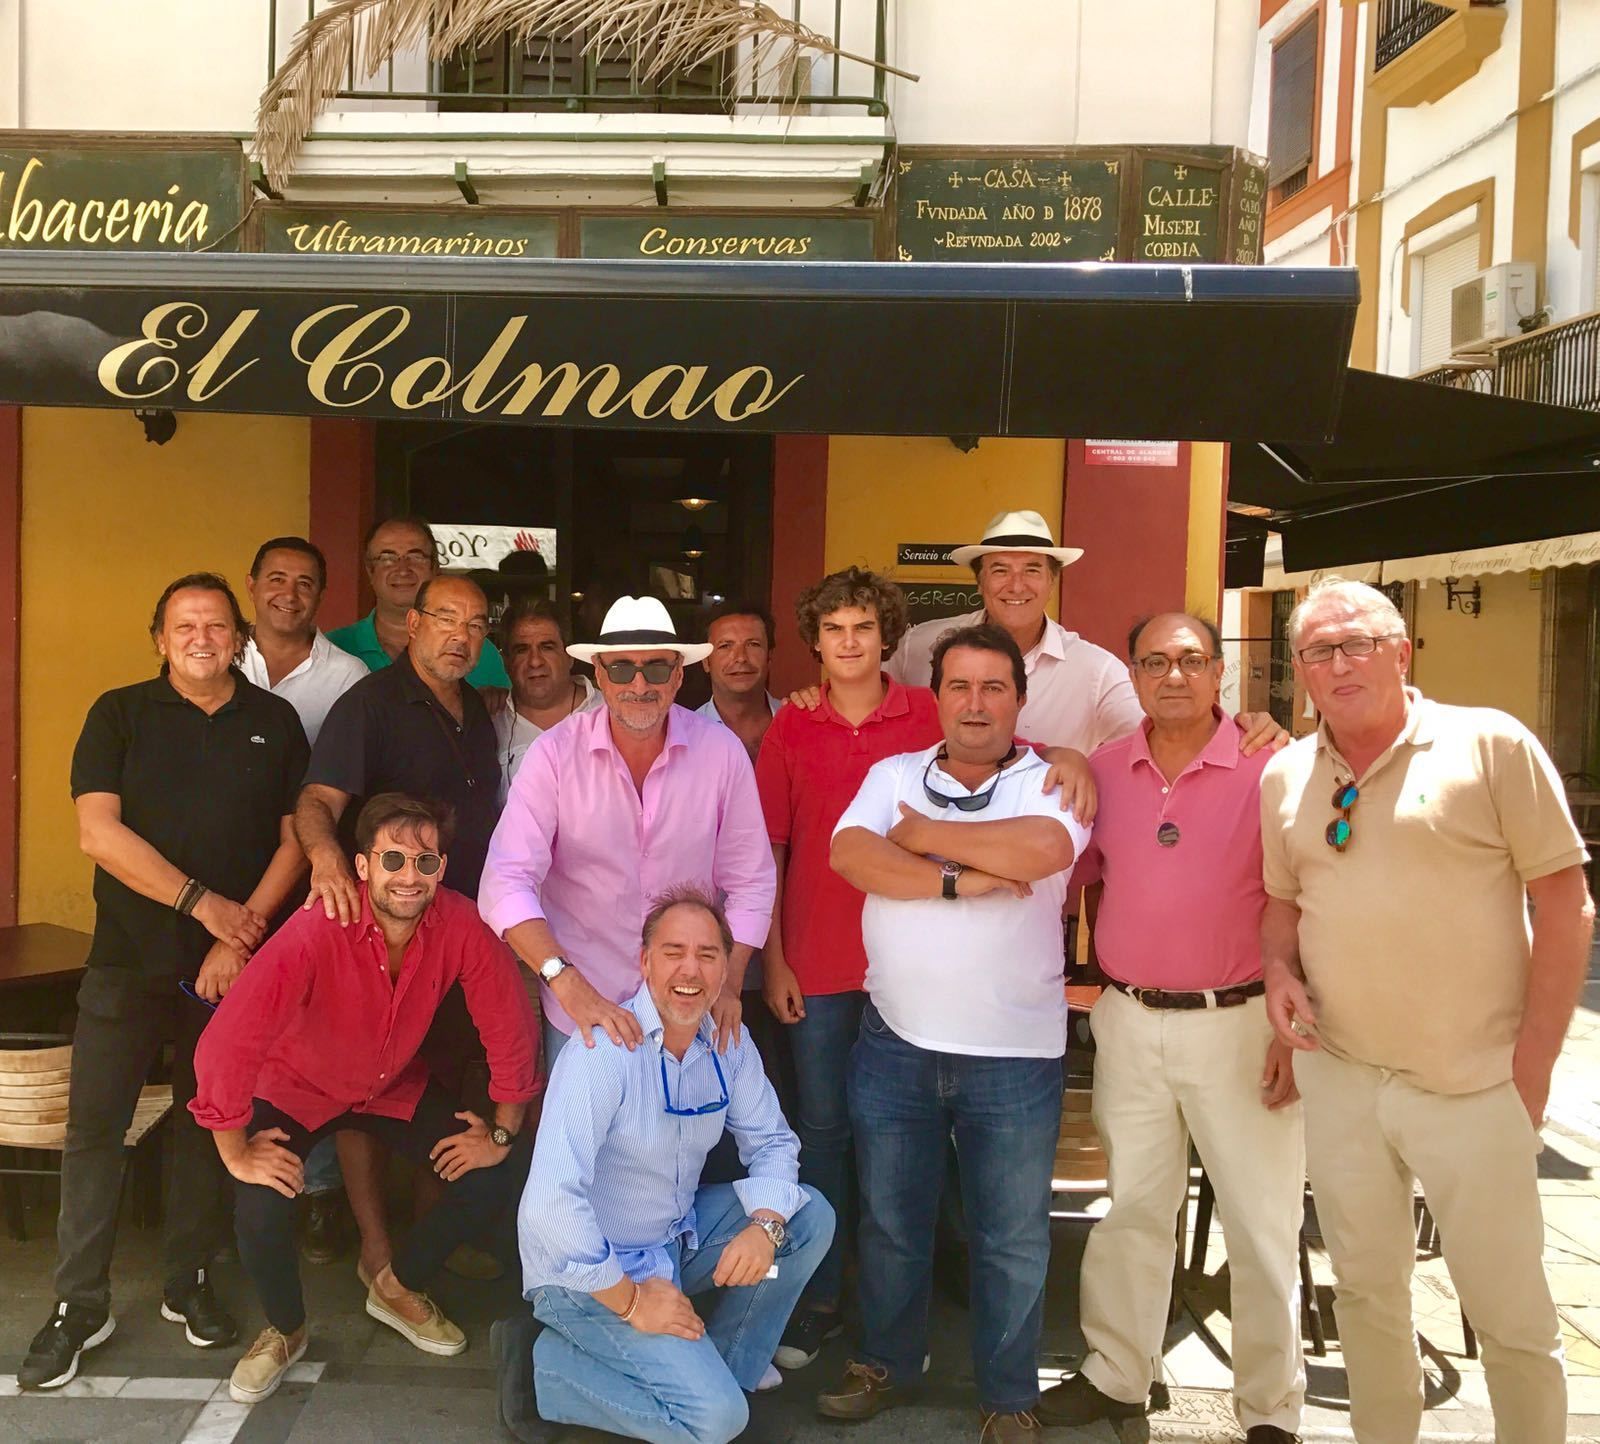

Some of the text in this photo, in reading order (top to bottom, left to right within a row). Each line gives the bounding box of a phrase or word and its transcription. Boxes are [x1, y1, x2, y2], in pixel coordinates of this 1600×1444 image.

[984, 168, 1037, 188] CASA
[0, 157, 209, 244] bacería
[1147, 185, 1214, 207] CALLE
[1002, 203, 1036, 221] AÑO
[1063, 196, 1102, 221] 1878
[286, 219, 529, 256] Ultramarinos
[639, 226, 812, 255] Conservas
[1029, 231, 1061, 248] 2002
[1144, 241, 1201, 258] CORDIA
[97, 301, 806, 422] El Colmao
[902, 548, 939, 561] Servicio
[904, 590, 983, 608] GERENC
